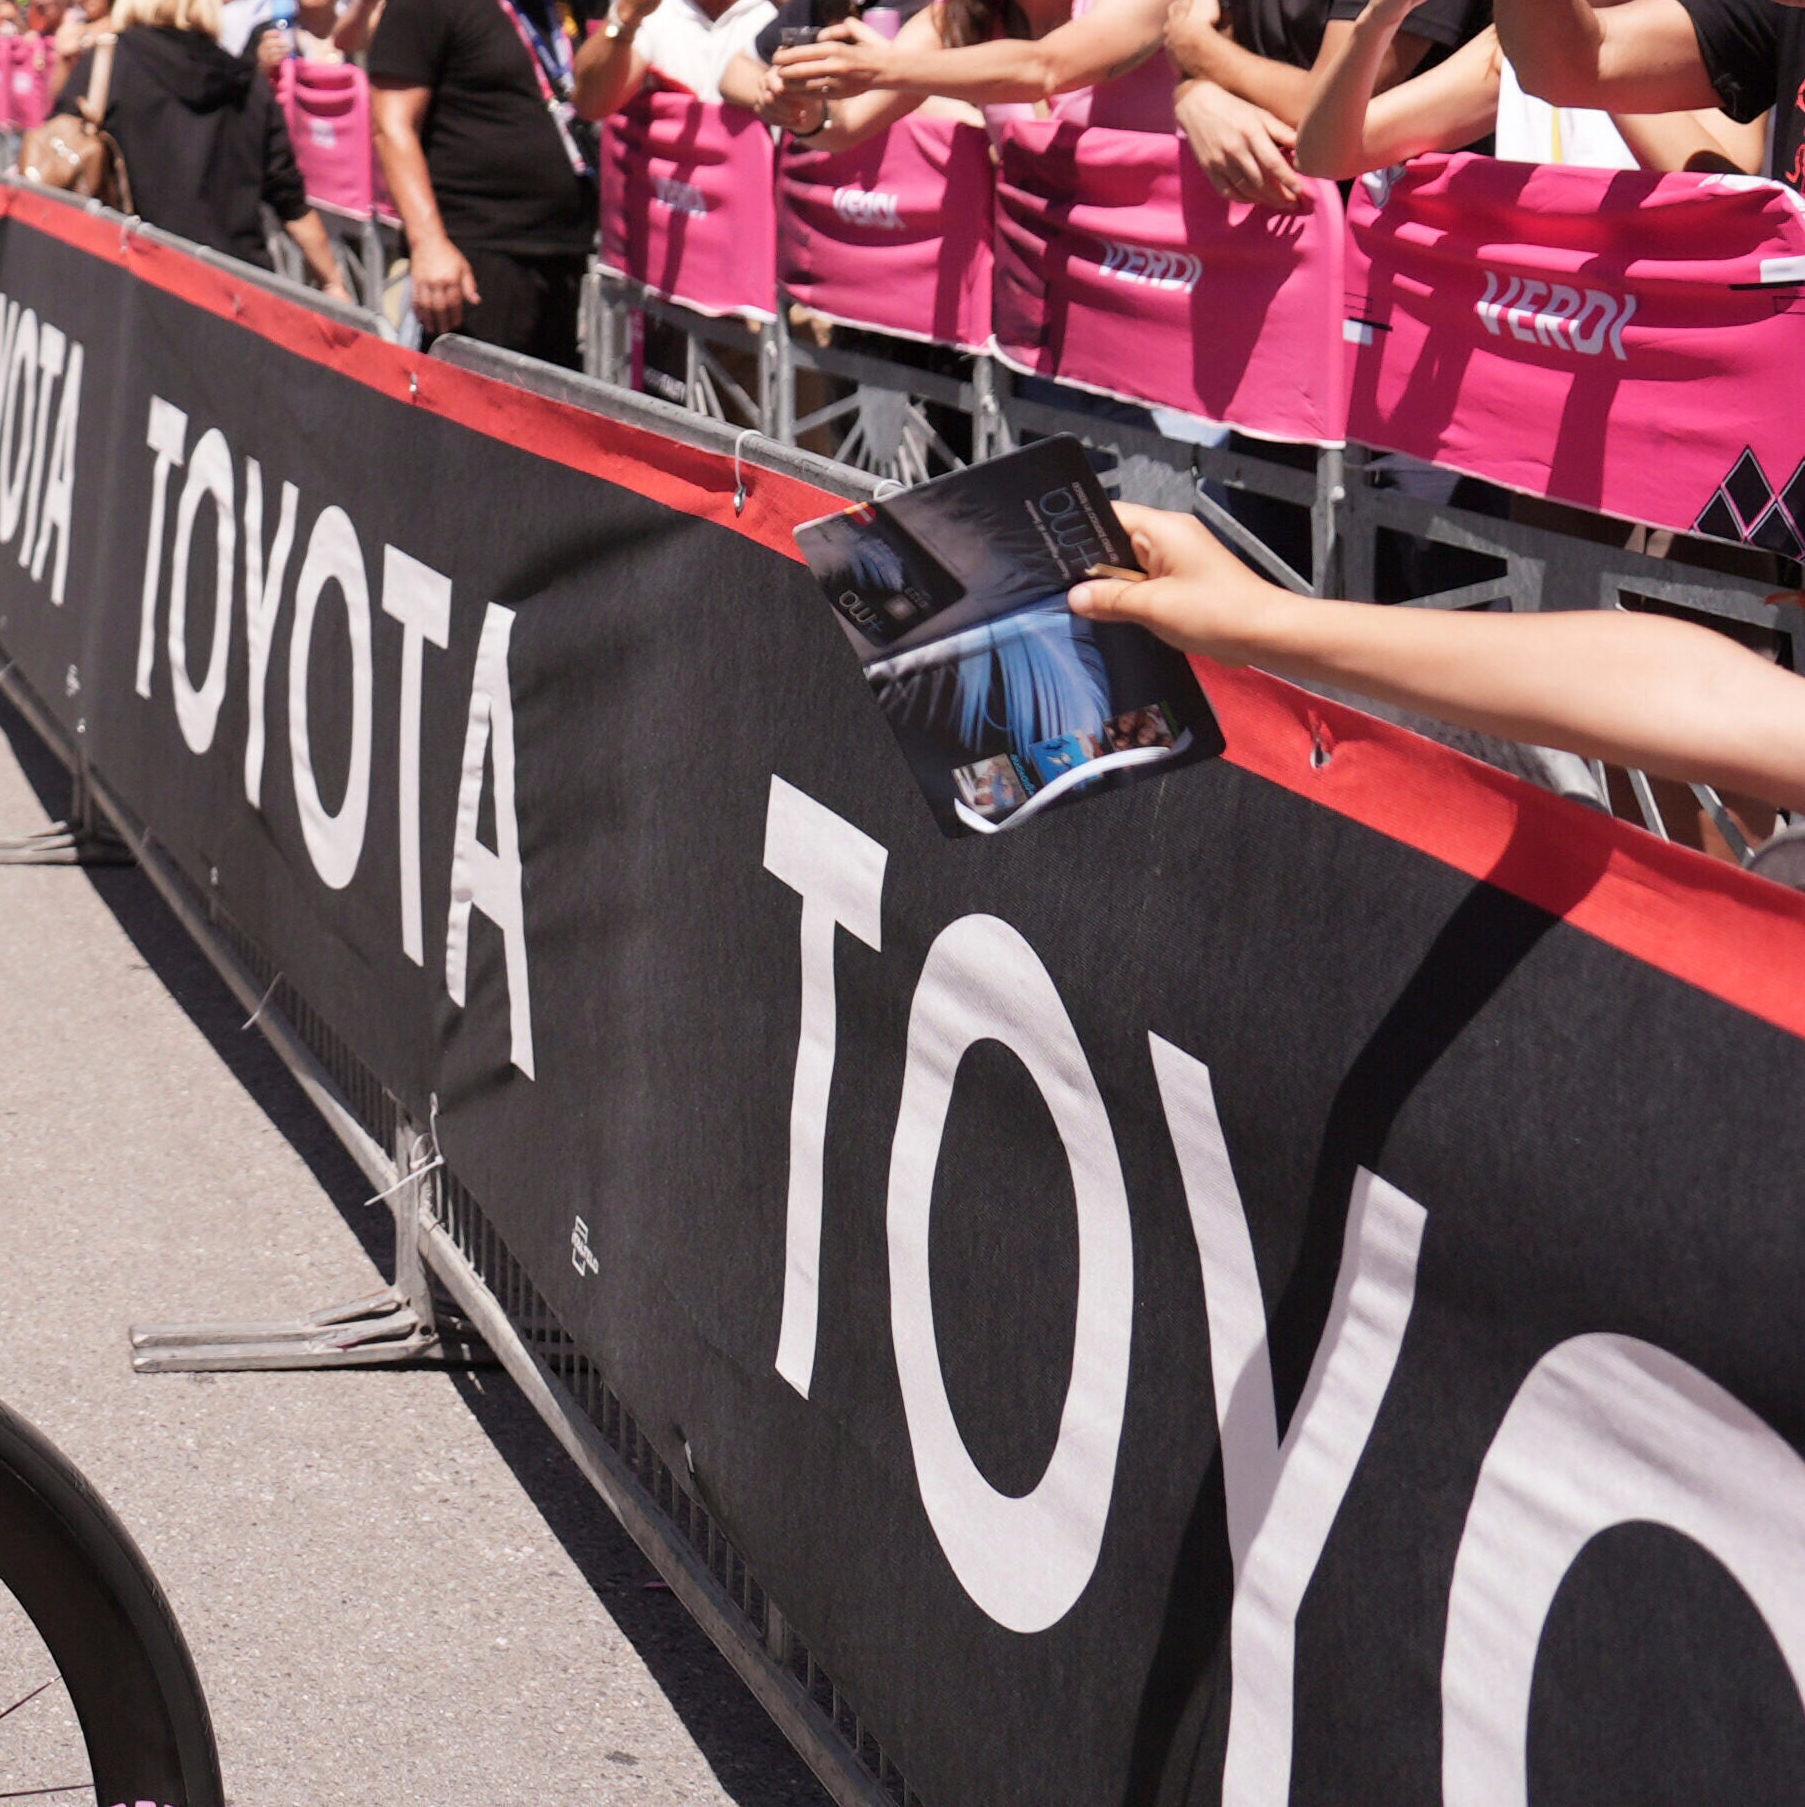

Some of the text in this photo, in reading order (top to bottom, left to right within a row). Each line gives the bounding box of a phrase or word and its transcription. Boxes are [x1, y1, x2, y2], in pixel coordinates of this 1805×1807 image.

[1098, 239, 1204, 295] VERDI
[1475, 269, 1637, 361] VERDI
[135, 396, 536, 1082] TOYOTA
